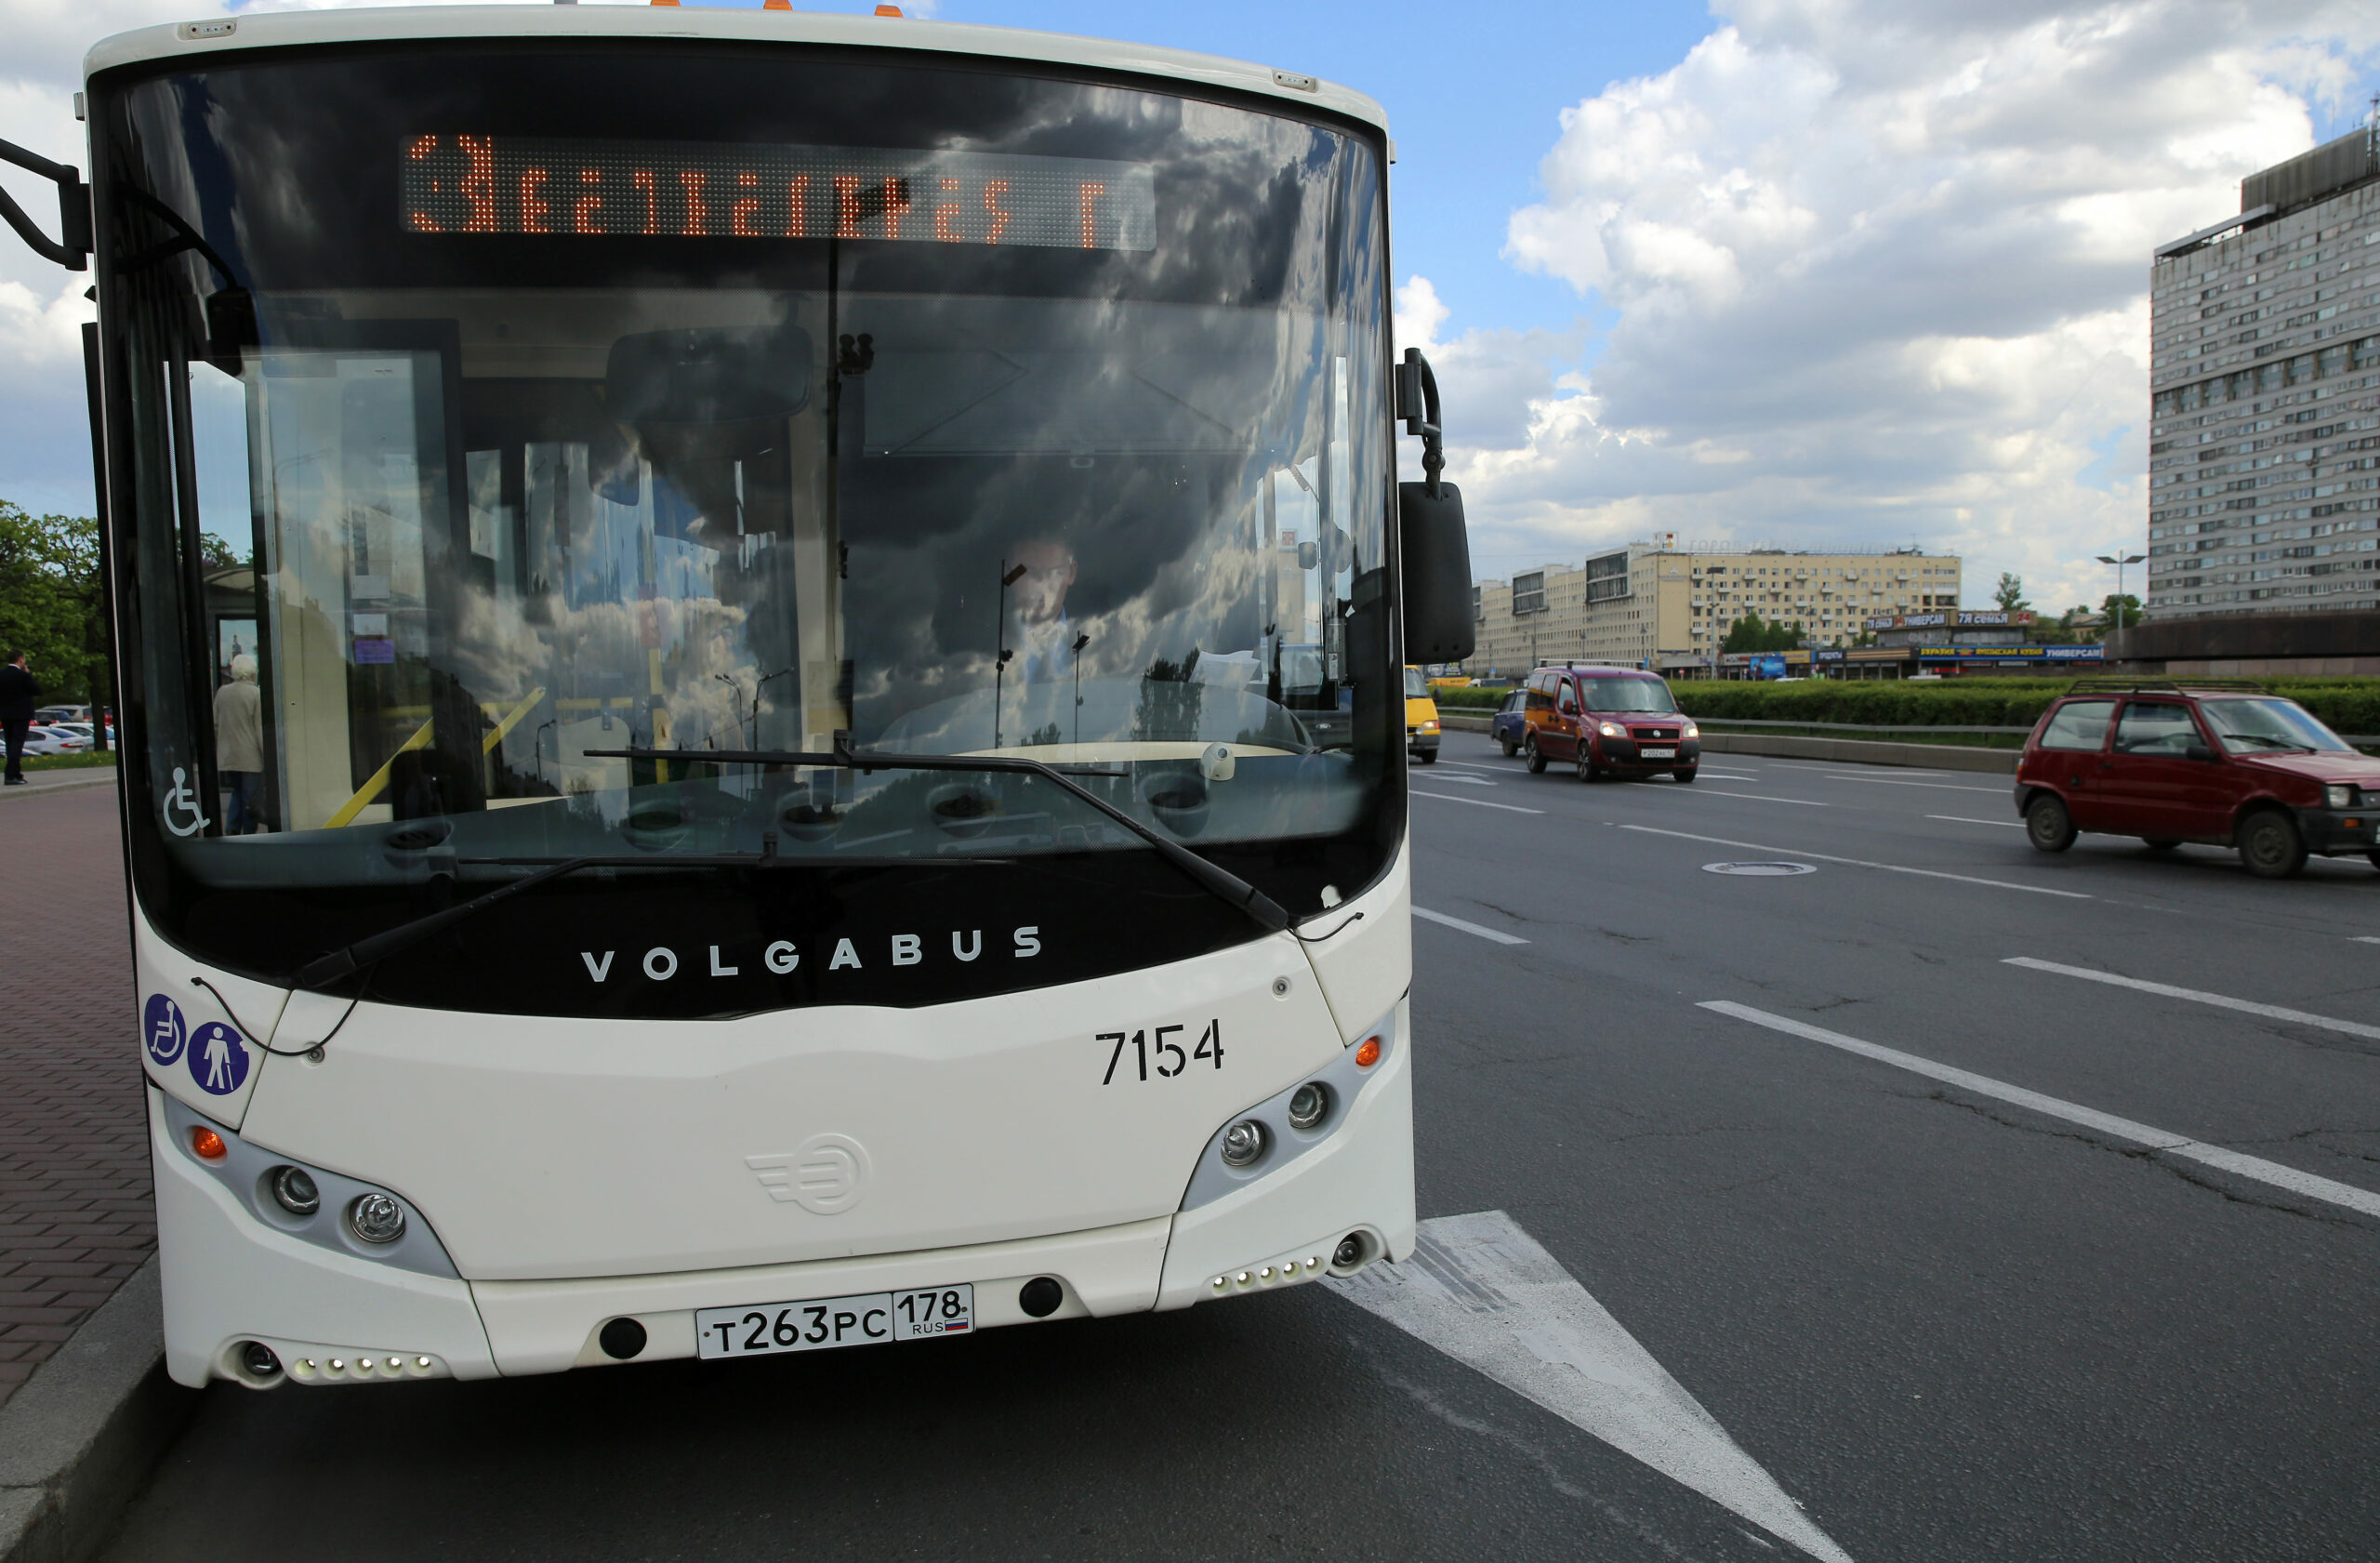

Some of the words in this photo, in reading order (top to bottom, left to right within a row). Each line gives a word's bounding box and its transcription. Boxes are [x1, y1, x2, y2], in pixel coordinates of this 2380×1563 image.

[1904, 614, 1945, 627] УНИВЕРСАМ
[1958, 614, 1972, 624] 7Я
[2046, 649, 2100, 657] УНИВЕРСАМ
[581, 926, 1041, 982] VOLGABUS
[1095, 1018, 1224, 1085] 7154
[713, 1305, 887, 1351] Т263РС
[897, 1290, 961, 1323] 178
[912, 1321, 944, 1335] RUS
